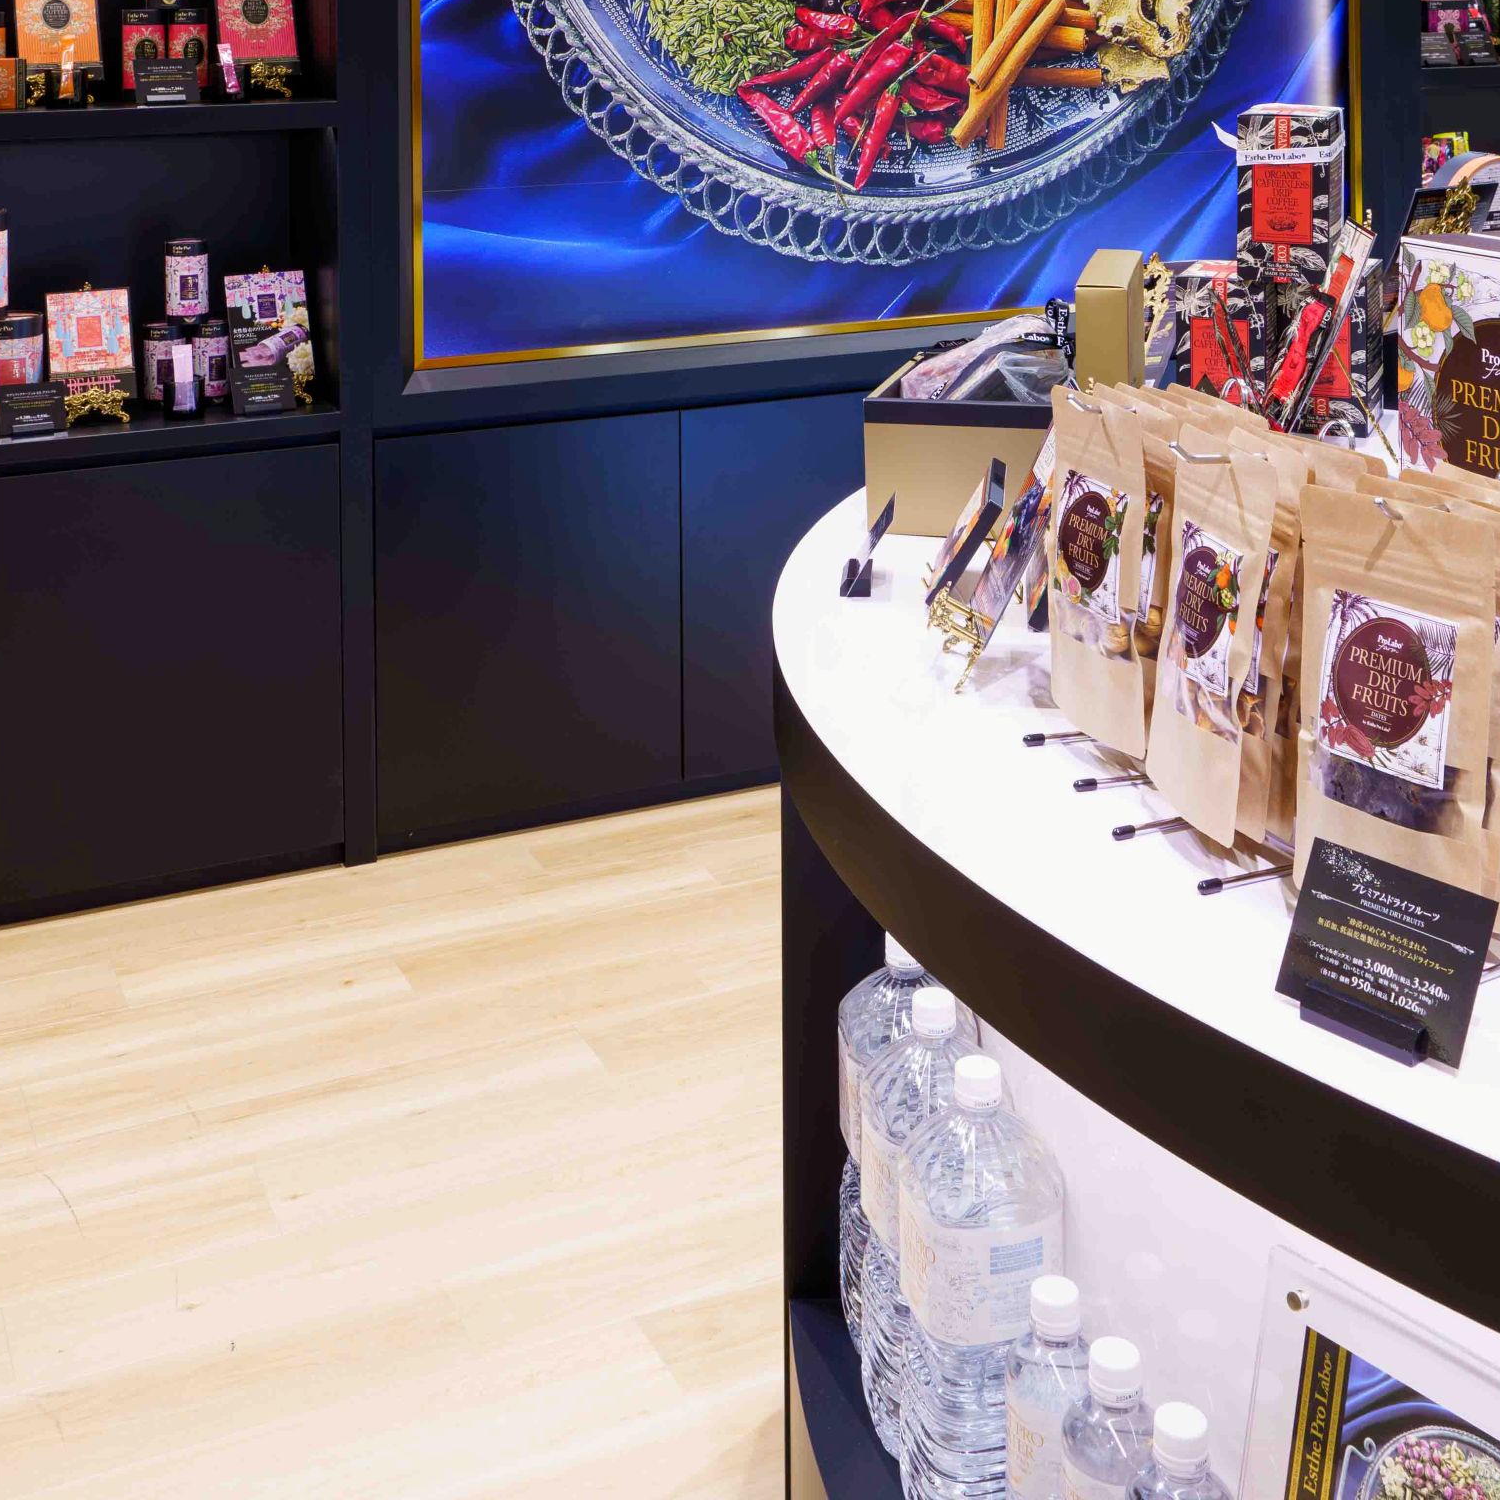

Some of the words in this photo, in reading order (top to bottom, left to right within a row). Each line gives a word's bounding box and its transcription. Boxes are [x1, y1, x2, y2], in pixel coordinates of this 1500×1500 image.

[1244, 153, 1266, 161] Esthe
[1266, 152, 1281, 161] Pro
[1255, 177, 1310, 189] CAFFEINLESS
[1264, 170, 1301, 180] ORGANIC
[1266, 197, 1299, 207] COFFEE
[1272, 188, 1293, 198] DRIP
[1069, 513, 1108, 541] PREMIUM
[1076, 532, 1095, 551] DRY
[1068, 545, 1099, 568] FRUITS
[1186, 591, 1202, 613] DRY
[1178, 606, 1209, 633] FRUITS
[1349, 646, 1422, 683] PREMIUM
[1368, 670, 1401, 694] DRY
[1351, 683, 1408, 717] FRUITS
[1371, 711, 1387, 721] DATES
[1352, 882, 1441, 921] プレミアムドライフルーツ
[1360, 899, 1389, 915] PREMIUM
[1389, 909, 1402, 919] DRY
[1402, 915, 1425, 928] FRUITS
[1309, 1403, 1326, 1438] Pro
[1303, 1438, 1324, 1496] Esthe
